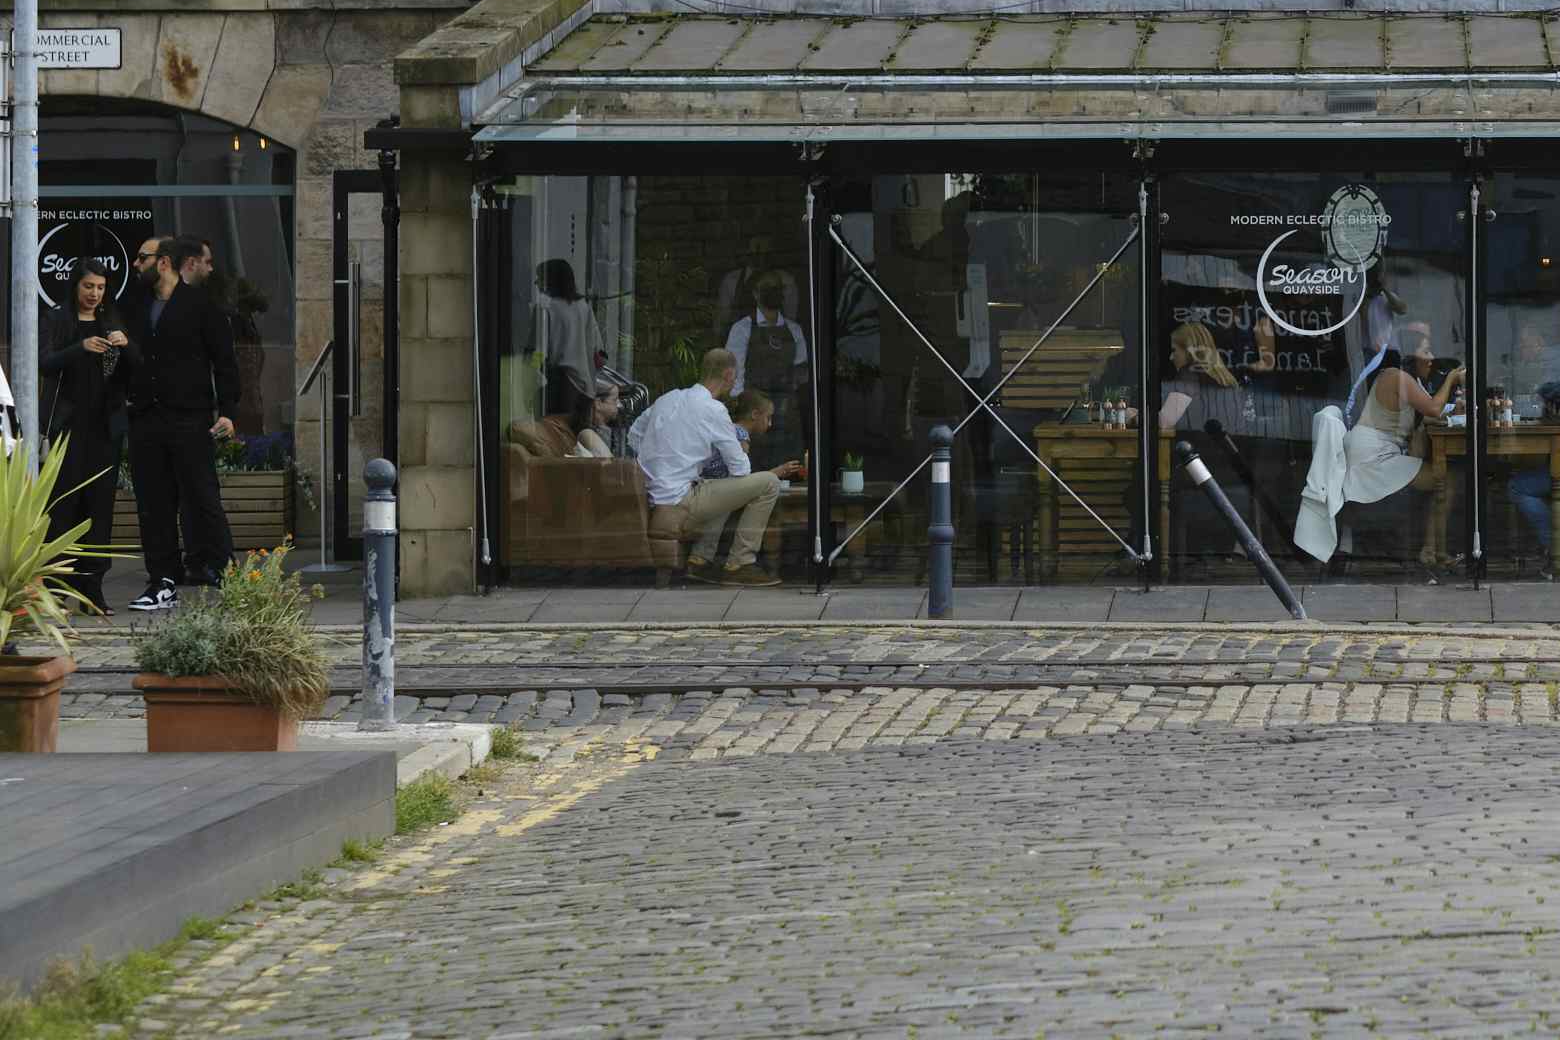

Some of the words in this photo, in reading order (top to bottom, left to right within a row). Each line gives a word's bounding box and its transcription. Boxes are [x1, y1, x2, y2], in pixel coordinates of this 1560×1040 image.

[37, 35, 111, 46] MMERCIAL
[41, 51, 90, 62] STREET
[59, 210, 110, 220] ECLECTIC
[113, 210, 152, 220] BISTRO
[1230, 215, 1283, 225] MODERN
[1286, 215, 1345, 225] ECLECTIC
[1348, 215, 1392, 225] BISTRO
[1269, 264, 1358, 286] Season
[1283, 285, 1340, 295] QUAYSIDE
